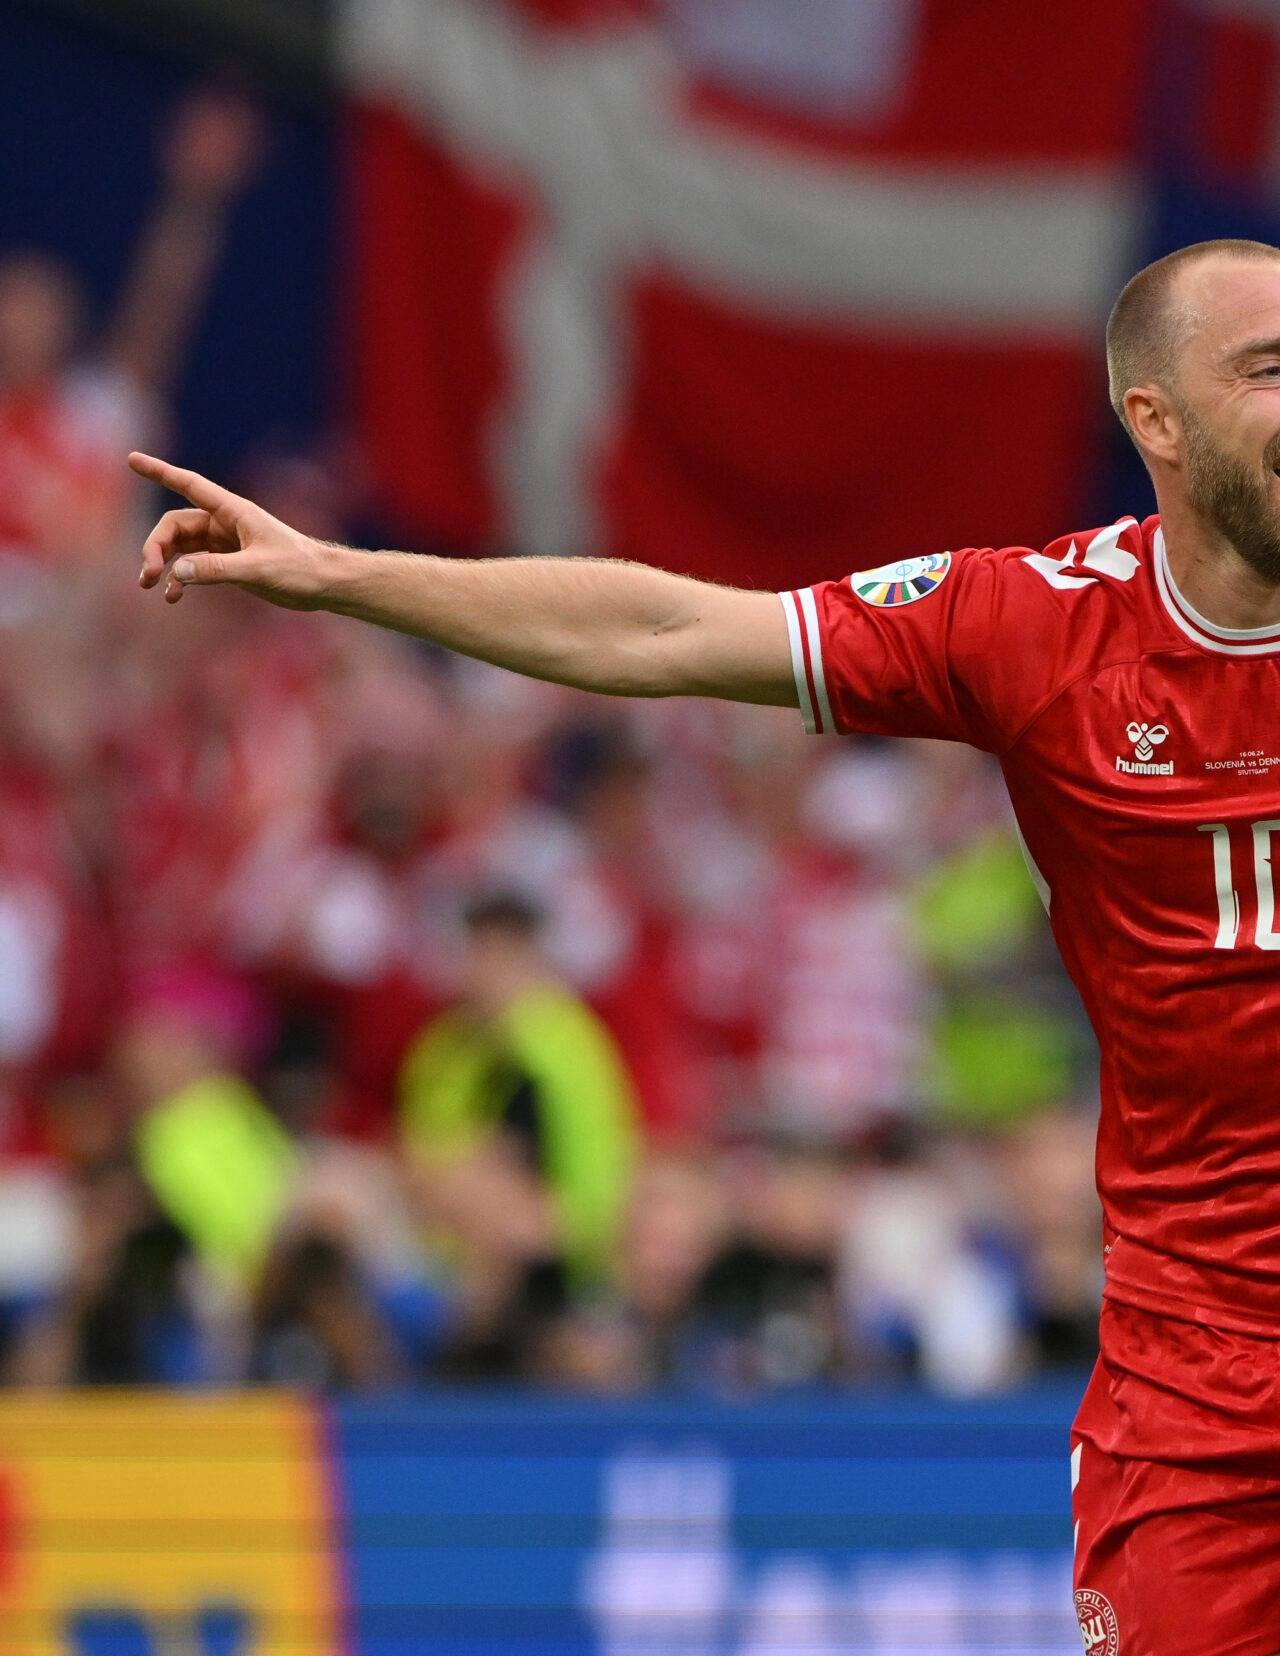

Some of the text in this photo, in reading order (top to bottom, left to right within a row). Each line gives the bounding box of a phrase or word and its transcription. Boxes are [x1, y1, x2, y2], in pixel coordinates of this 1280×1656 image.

[1115, 755, 1174, 776] hummel
[1205, 760, 1246, 770] SLOVENIA
[1237, 768, 1269, 776] STUTTGART
